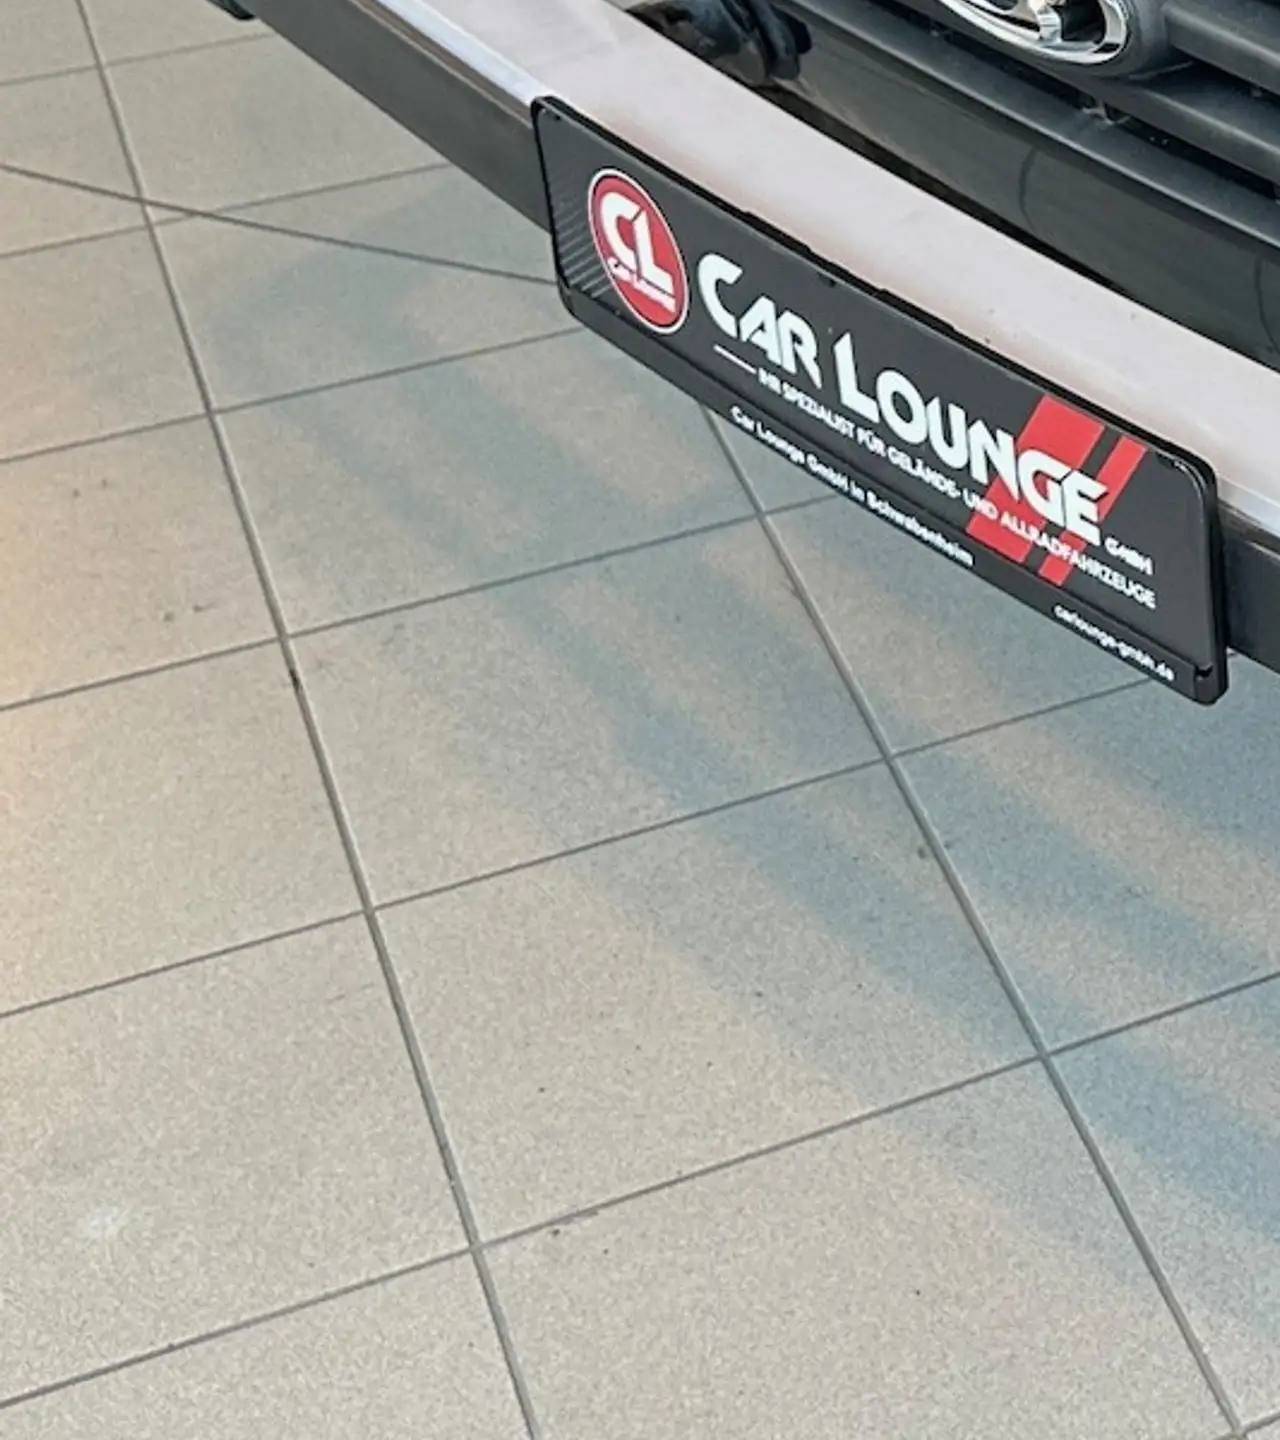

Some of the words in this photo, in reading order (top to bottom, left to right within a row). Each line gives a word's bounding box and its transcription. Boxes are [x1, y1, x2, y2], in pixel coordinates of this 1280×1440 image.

[601, 191, 675, 297] CL
[698, 252, 823, 390] CAR
[833, 332, 1108, 547] LOUNGE
[731, 405, 756, 431] Car
[755, 421, 806, 465] Lounge
[806, 453, 849, 492] GmbH
[781, 381, 855, 438] SPEZIALIST
[856, 426, 886, 458] FÜR
[962, 488, 1000, 521] UND
[1000, 511, 1156, 610] ALLRADFAHRZEUGE
